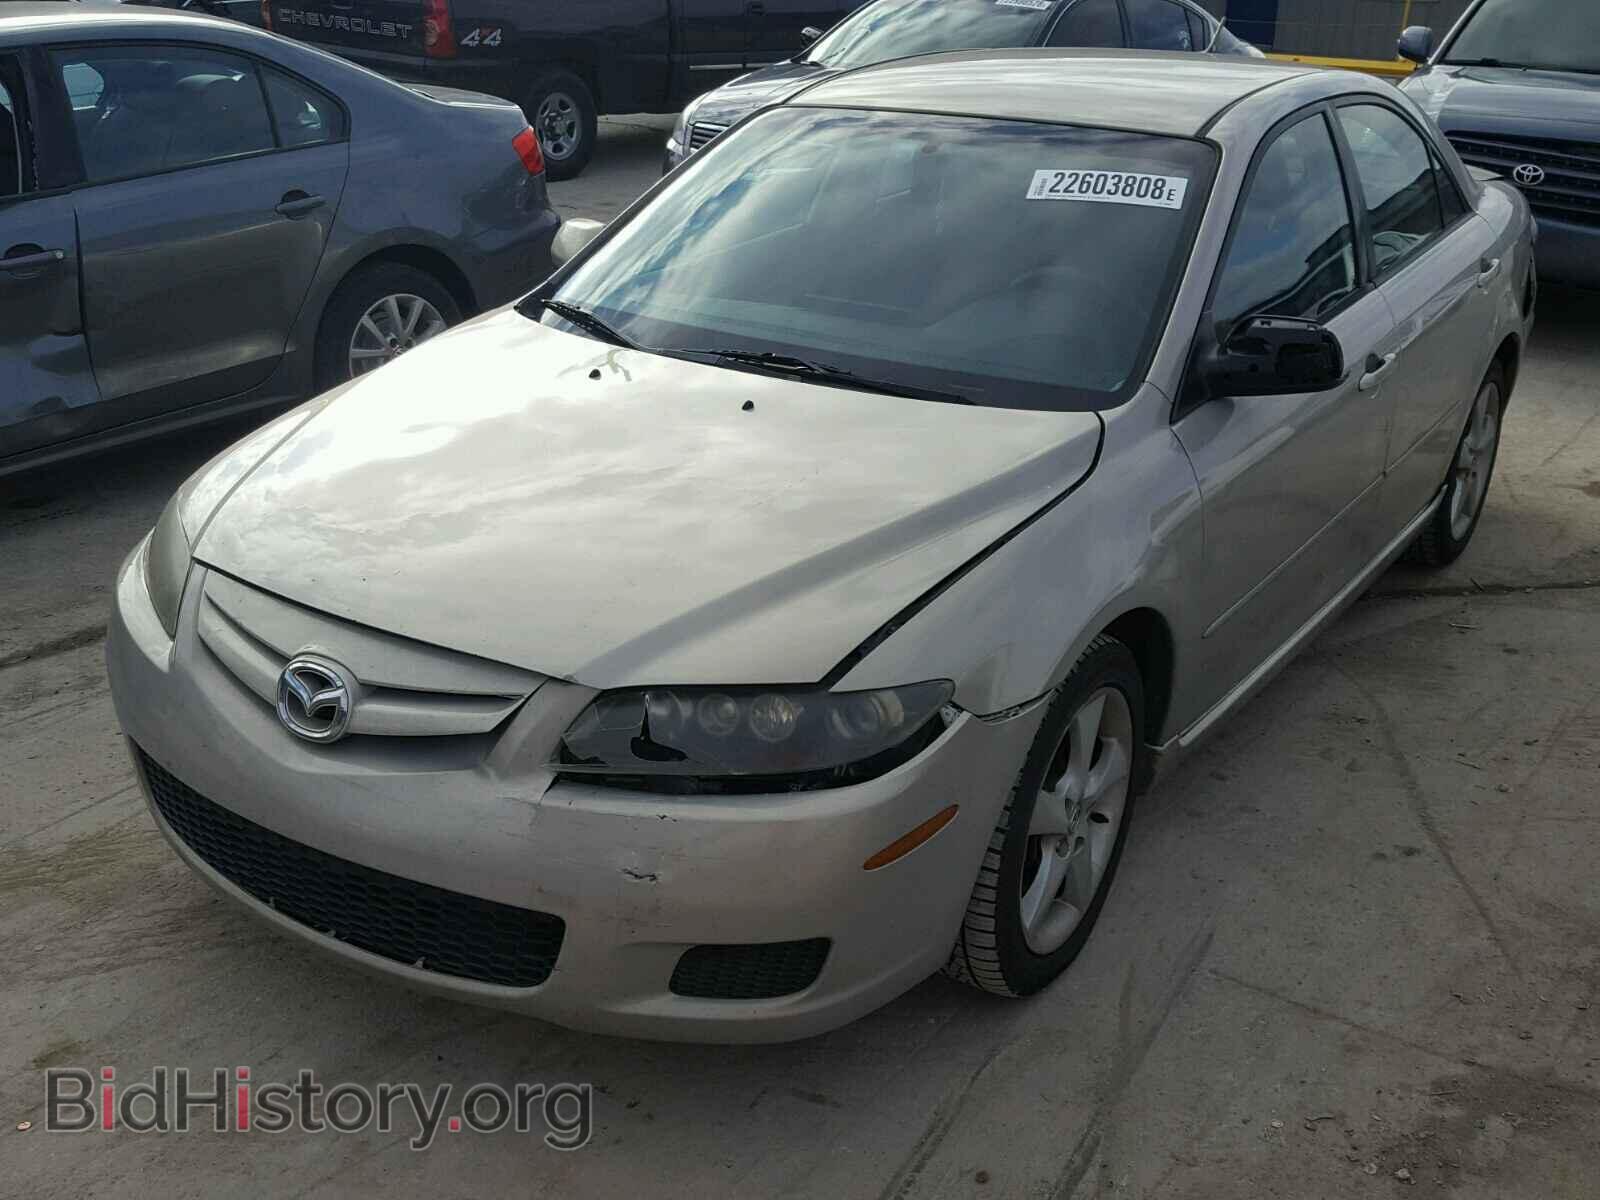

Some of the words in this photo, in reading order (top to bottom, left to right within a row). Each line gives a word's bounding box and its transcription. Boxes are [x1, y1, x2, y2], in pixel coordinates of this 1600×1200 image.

[279, 8, 413, 39] CHEVROLET
[1049, 171, 1167, 200] 22603808
[1167, 188, 1177, 201] E
